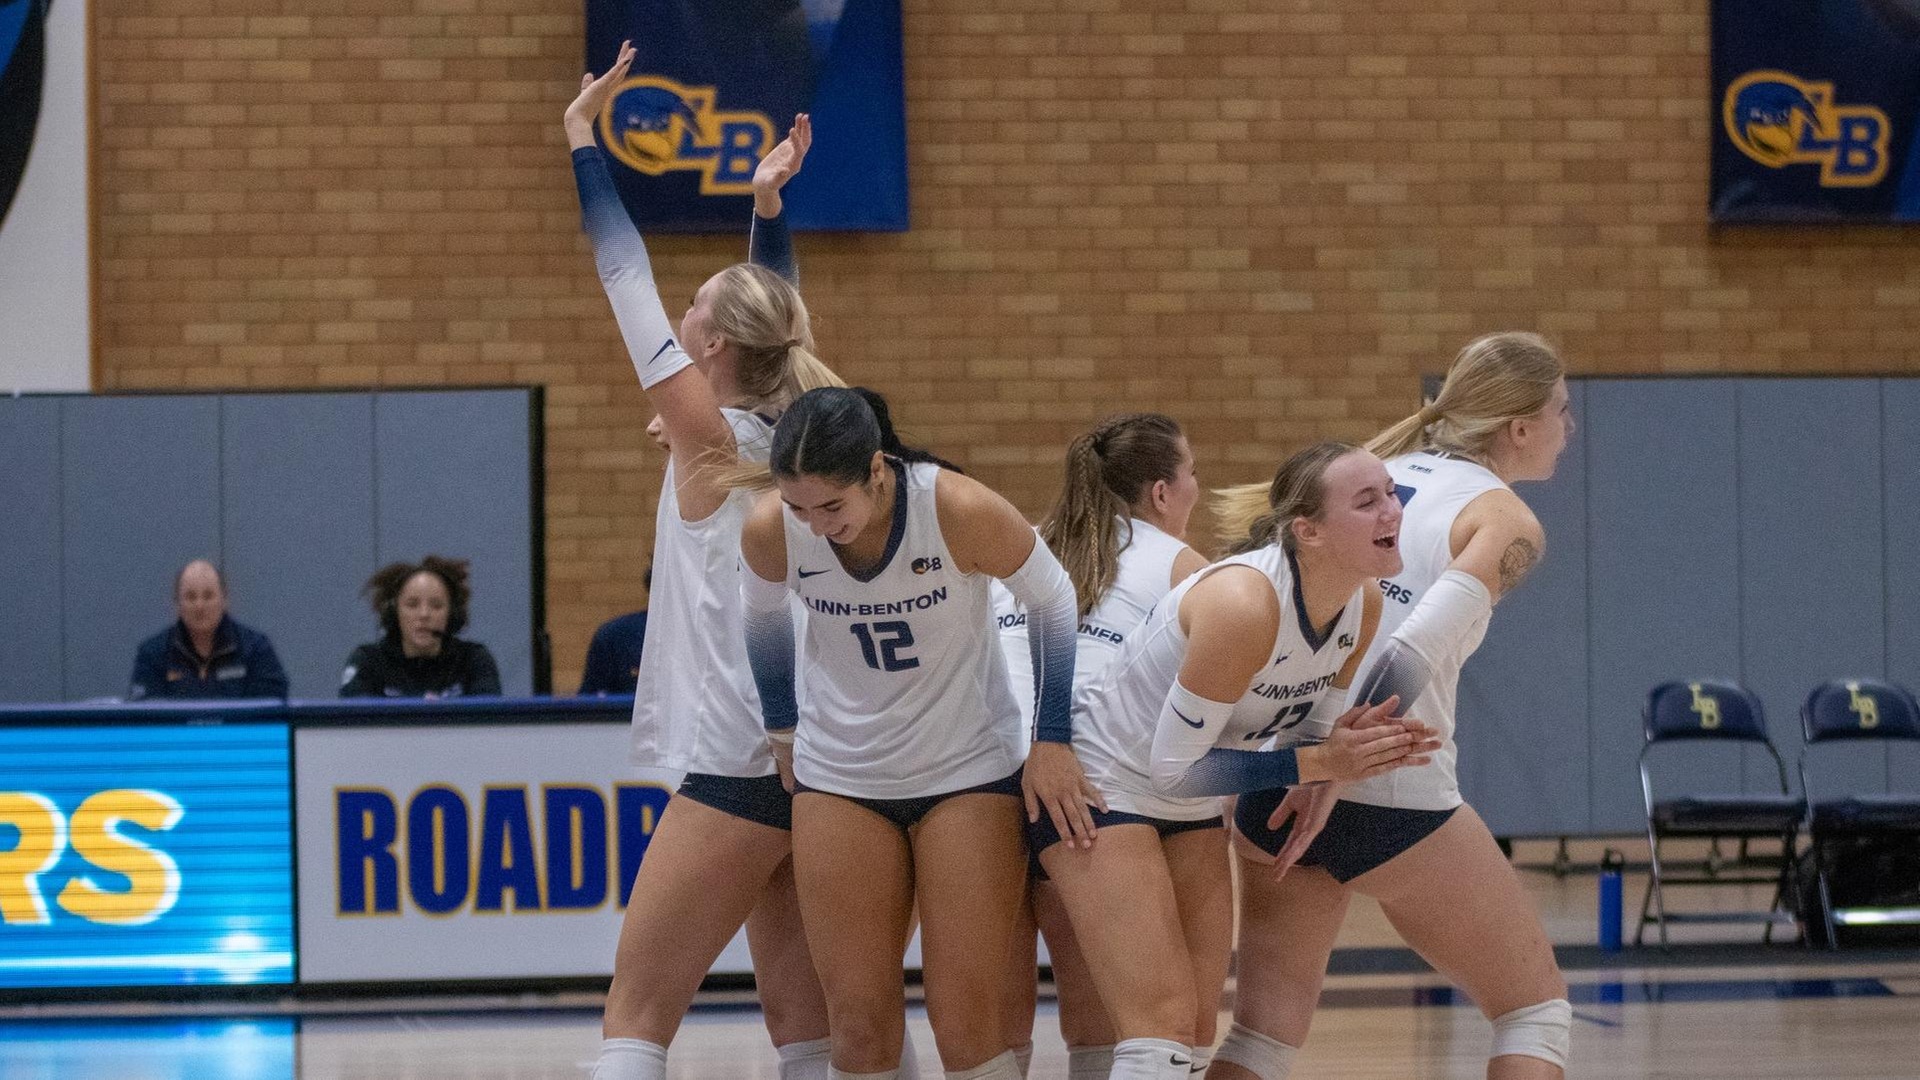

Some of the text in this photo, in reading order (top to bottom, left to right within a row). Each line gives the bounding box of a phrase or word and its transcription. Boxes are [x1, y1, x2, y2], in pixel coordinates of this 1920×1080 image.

[805, 586, 948, 616] LINN-BENTON
[1376, 578, 1413, 605] ERS
[849, 620, 920, 673] 12
[1251, 671, 1337, 700] LINN-BENTO
